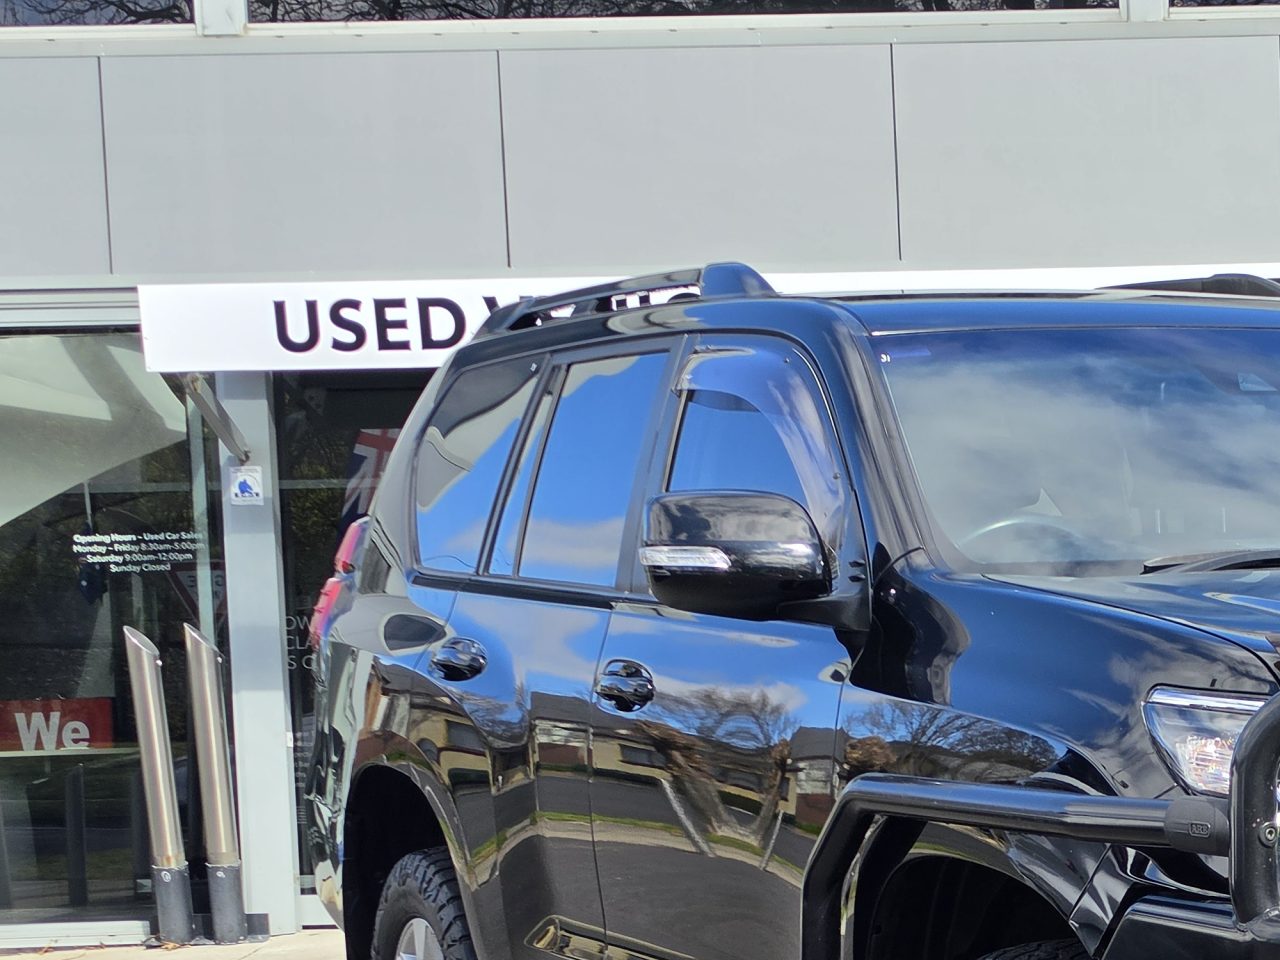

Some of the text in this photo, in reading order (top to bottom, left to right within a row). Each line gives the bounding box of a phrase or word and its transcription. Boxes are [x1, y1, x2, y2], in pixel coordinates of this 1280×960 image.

[273, 296, 467, 353] USED
[73, 533, 111, 544] Opening
[111, 533, 137, 541] Hours
[143, 532, 165, 540] Used
[165, 532, 180, 540] Car
[72, 544, 107, 554] Monday
[114, 543, 140, 553] Friday
[86, 553, 124, 564] Saturday
[109, 562, 171, 573] Sunday Closed
[14, 711, 91, 751] We
